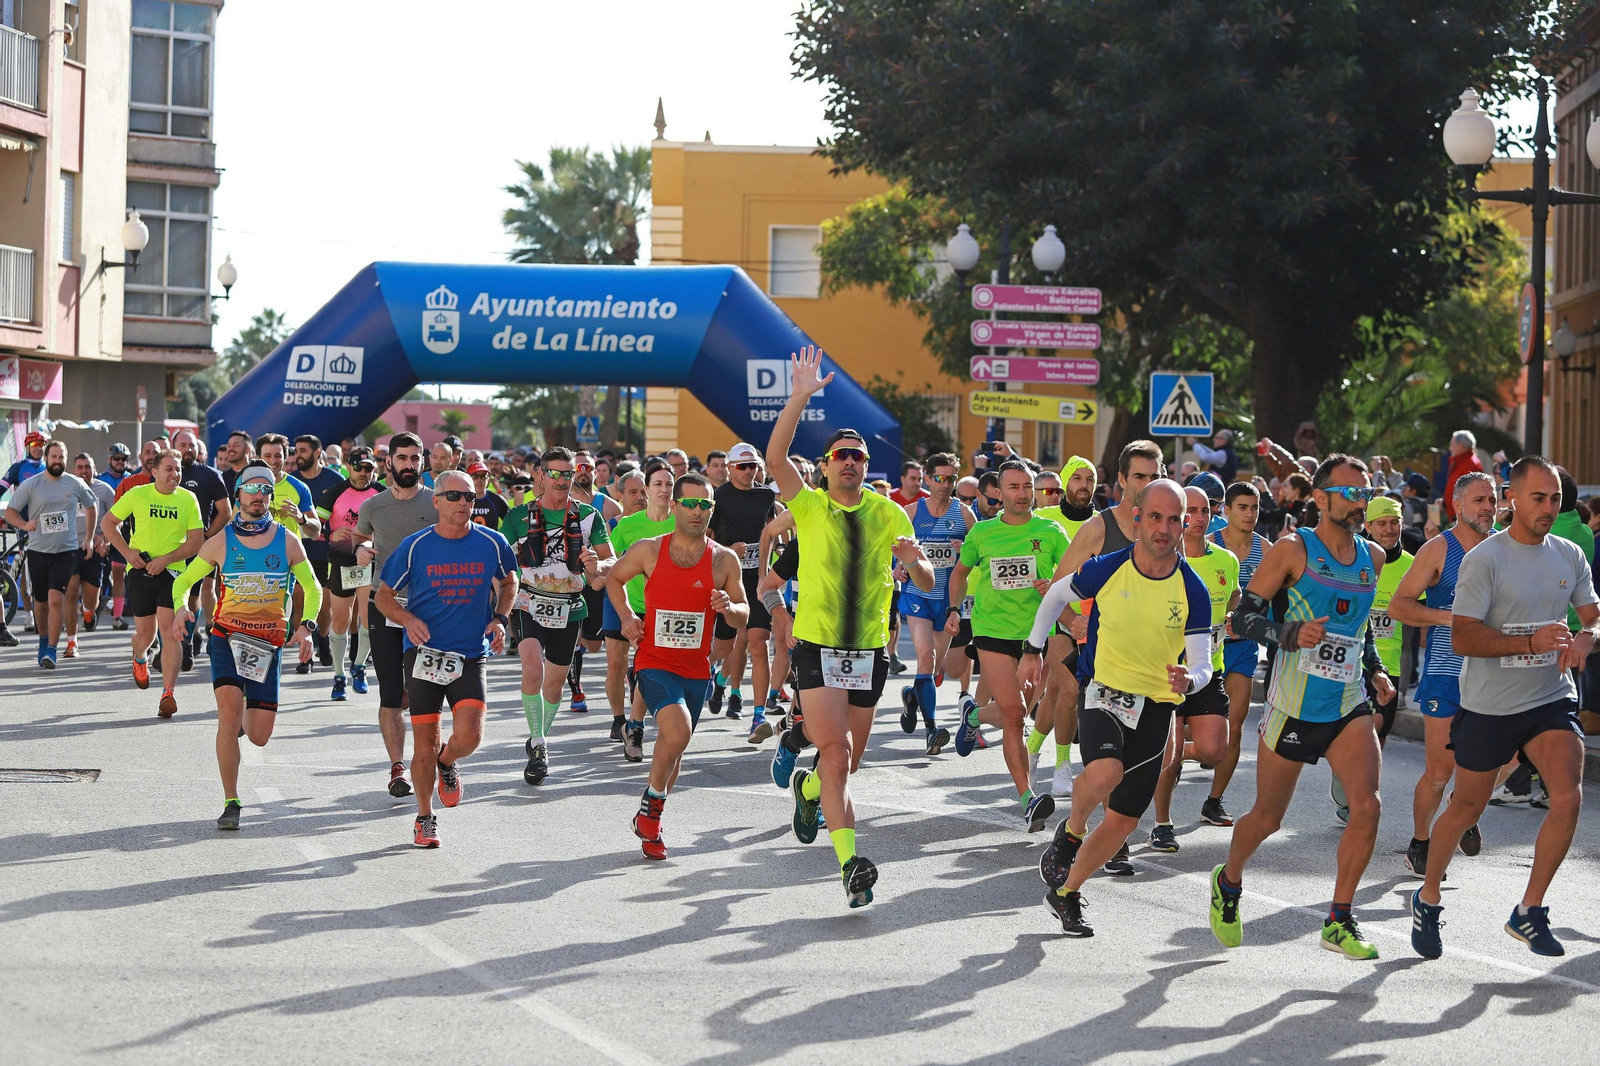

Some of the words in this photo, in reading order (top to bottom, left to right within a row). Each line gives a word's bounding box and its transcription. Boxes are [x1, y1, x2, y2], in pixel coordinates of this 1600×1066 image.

[468, 292, 678, 323] Ayuntamiento
[492, 325, 528, 350] de
[534, 327, 568, 351] La
[574, 328, 655, 352] Línea
[1024, 330, 1051, 339] Virgen
[1066, 332, 1097, 341] Europa
[296, 353, 316, 373] D
[756, 368, 776, 390] D
[284, 381, 334, 392] DELEGACIÓN
[283, 392, 360, 408] DEPORTES
[973, 394, 1040, 406] Ayuntamiento
[750, 409, 826, 422] DEPTES
[972, 404, 990, 412] City
[992, 406, 1010, 414] Hall
[45, 516, 64, 526] 139
[150, 508, 178, 520] RUN
[926, 548, 952, 559] 300
[350, 570, 364, 579] 83
[426, 562, 485, 577] FINISHER
[998, 564, 1030, 578] 238
[535, 604, 562, 616] 281
[230, 618, 277, 630] Algeciras
[664, 620, 697, 635] 125
[240, 651, 259, 668] 82
[1319, 644, 1346, 664] 68
[422, 655, 456, 673] 315
[841, 659, 853, 674] 8
[527, 701, 539, 737] Kalenji
